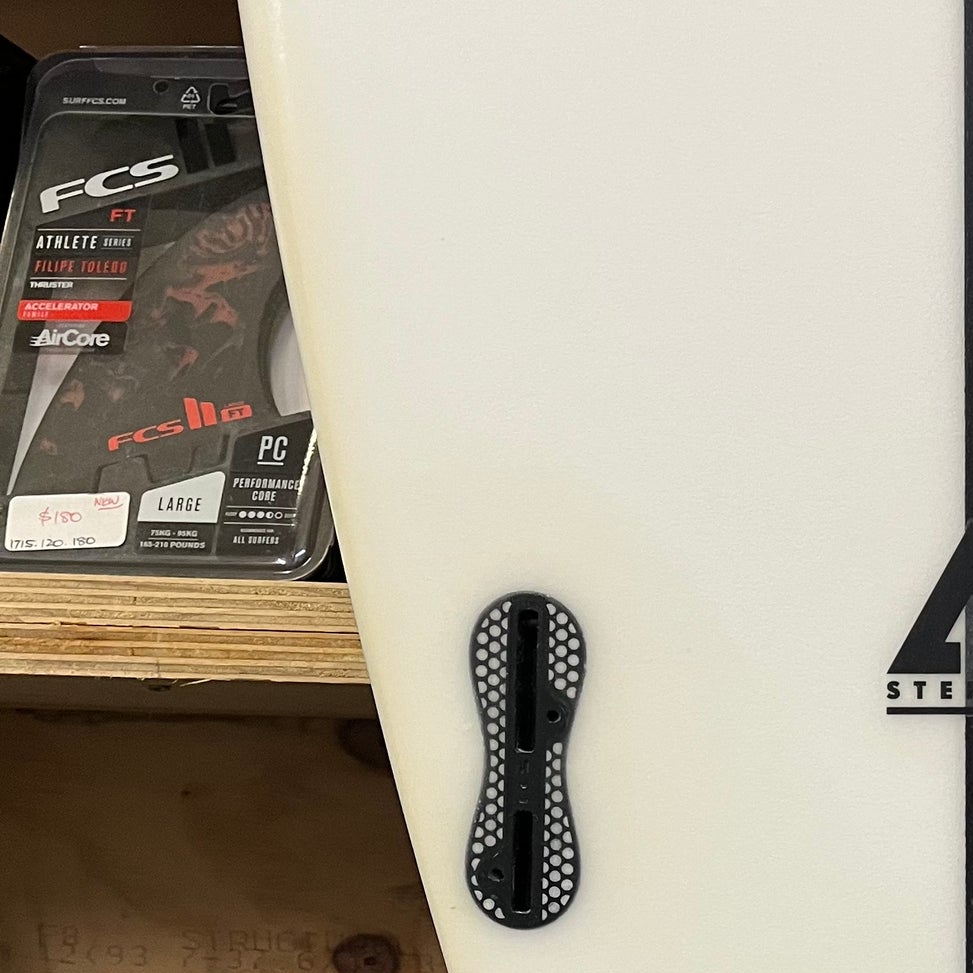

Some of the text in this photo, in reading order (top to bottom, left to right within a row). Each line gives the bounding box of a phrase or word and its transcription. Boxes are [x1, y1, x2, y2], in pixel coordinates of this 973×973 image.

[63, 97, 127, 105] SURFFCS.COM
[39, 154, 180, 214] FCS
[109, 208, 137, 223] FT
[36, 235, 132, 249] ATHLETE SERIES
[34, 260, 128, 274] FILIPE TOLEDO
[30, 281, 74, 289] THRUSTER
[24, 302, 99, 311] ACCELERATOR
[29, 328, 111, 347] AirCore
[108, 418, 184, 451] FCS
[257, 435, 289, 461] PC
[232, 477, 300, 491] PERFORMANCE
[94, 495, 120, 507] NEW
[251, 490, 277, 502] CORE
[157, 496, 203, 512] LARGE
[38, 507, 83, 527] $180
[150, 529, 171, 537] 75KG
[232, 535, 280, 545] ALL SURFERS
[170, 541, 206, 549] POUNDS
